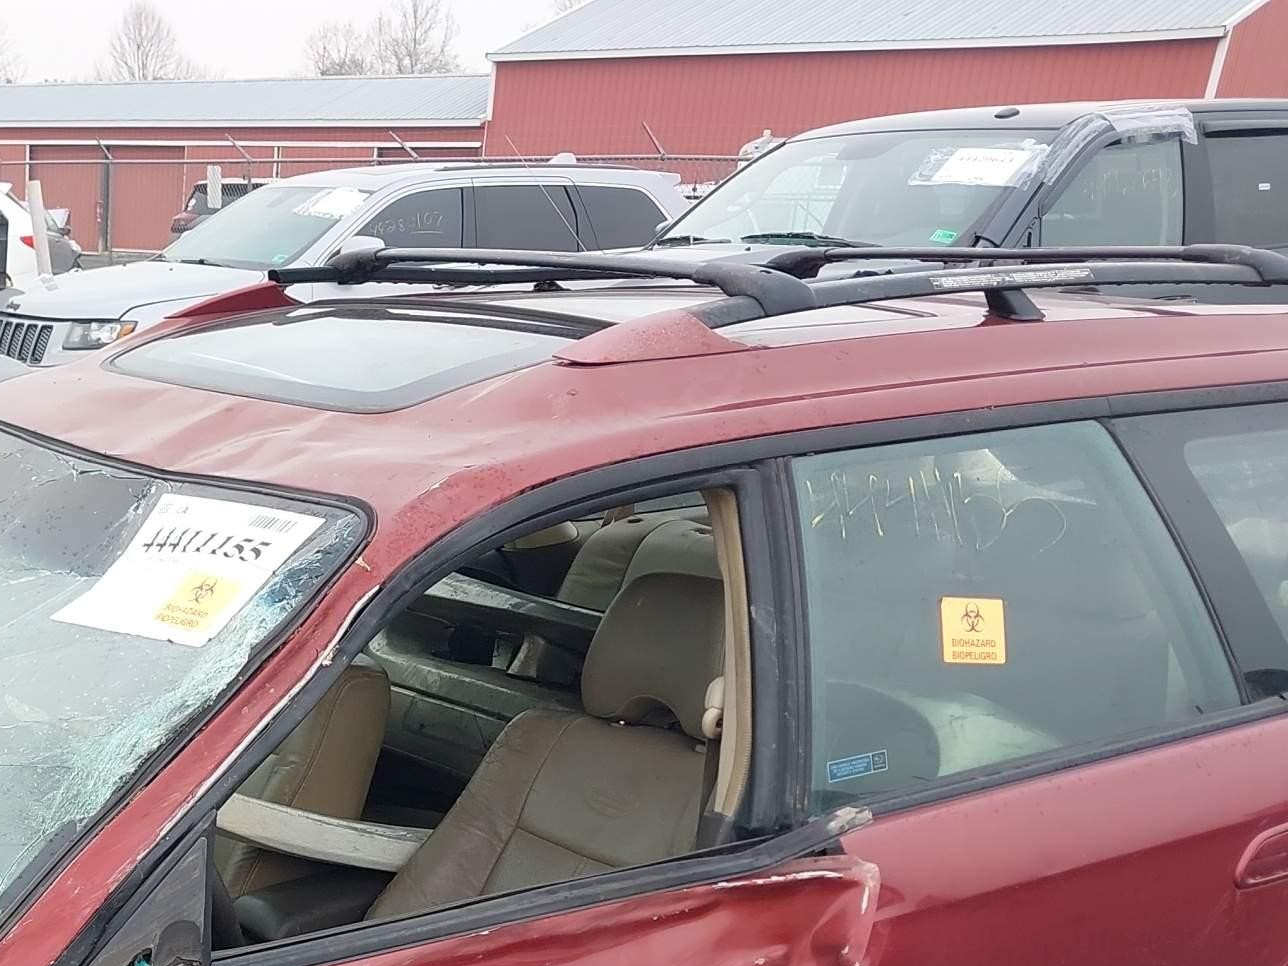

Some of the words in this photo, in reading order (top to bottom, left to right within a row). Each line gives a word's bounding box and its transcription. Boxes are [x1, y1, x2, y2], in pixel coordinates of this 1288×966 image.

[143, 528, 272, 561] 44411155
[951, 638, 997, 648] BIOHAZARD
[951, 650, 998, 661] BIOPELIGRO
